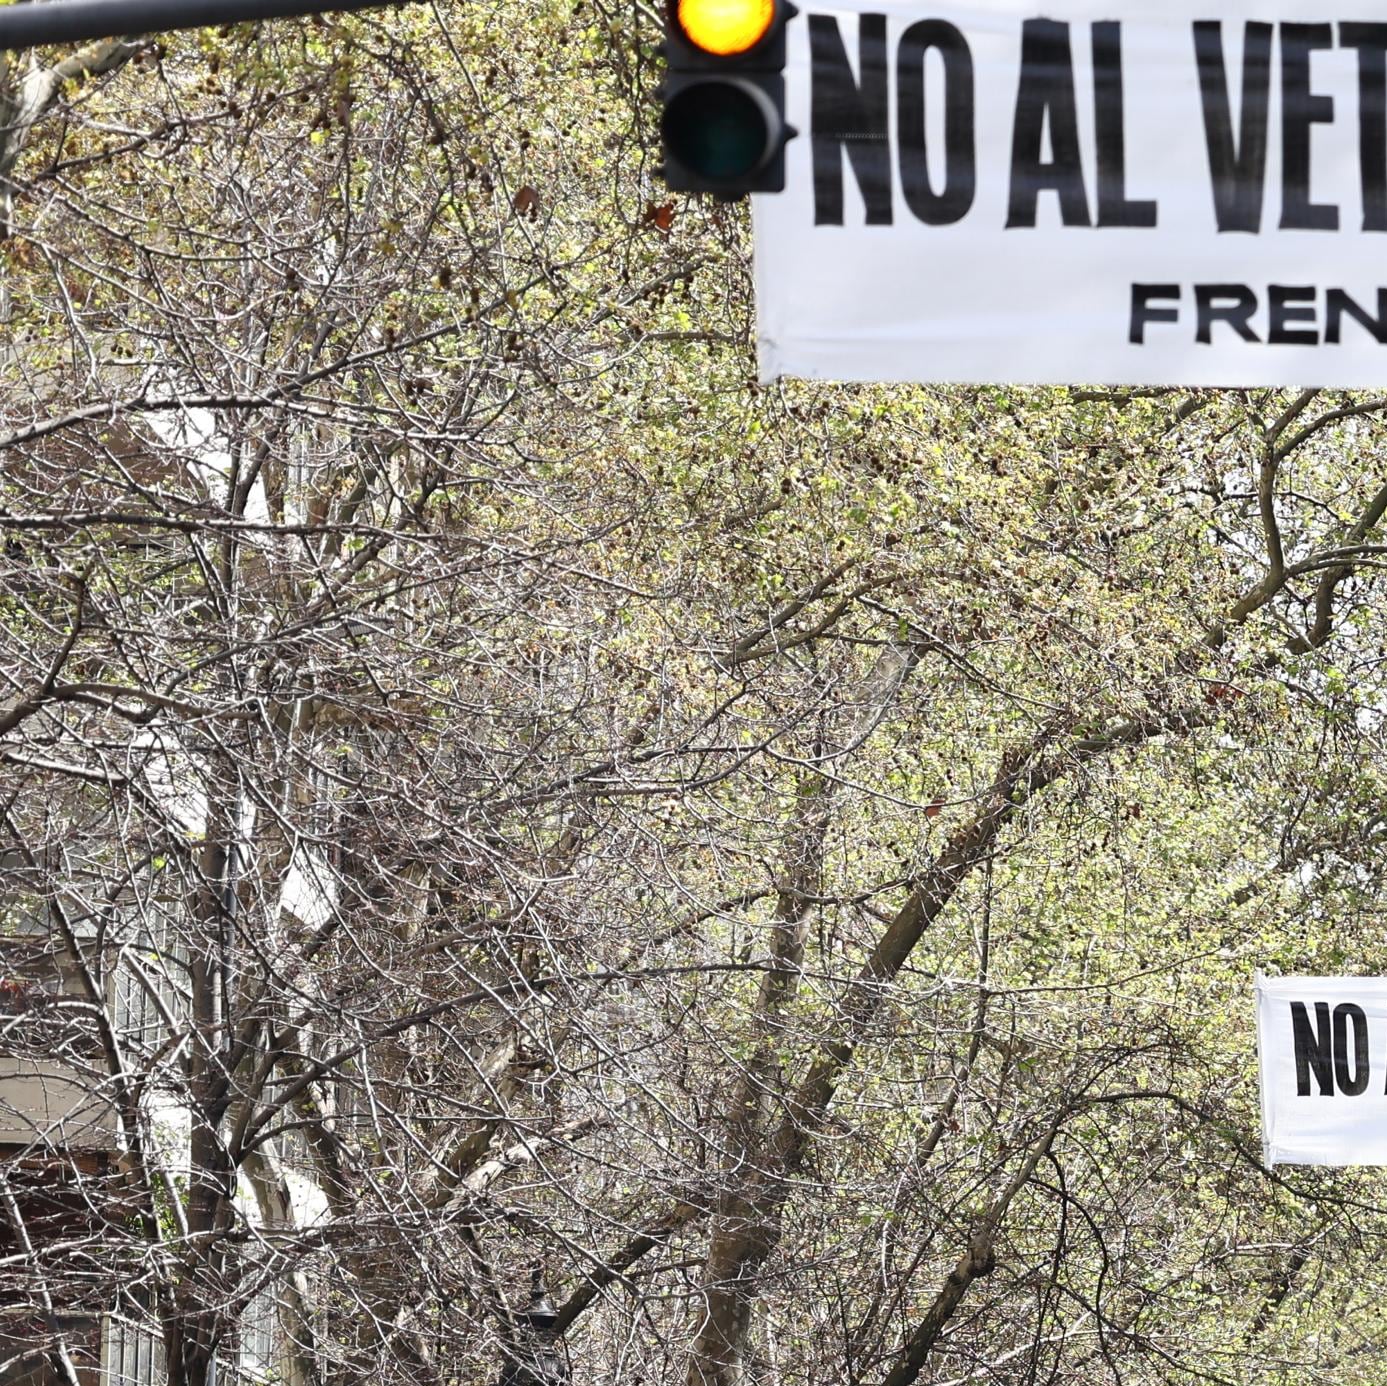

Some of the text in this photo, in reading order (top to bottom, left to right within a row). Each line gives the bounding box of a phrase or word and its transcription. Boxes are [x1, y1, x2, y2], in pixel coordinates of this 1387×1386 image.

[808, 13, 975, 226] NO
[1005, 17, 1157, 229] AL
[1290, 1002, 1369, 1096] NO
